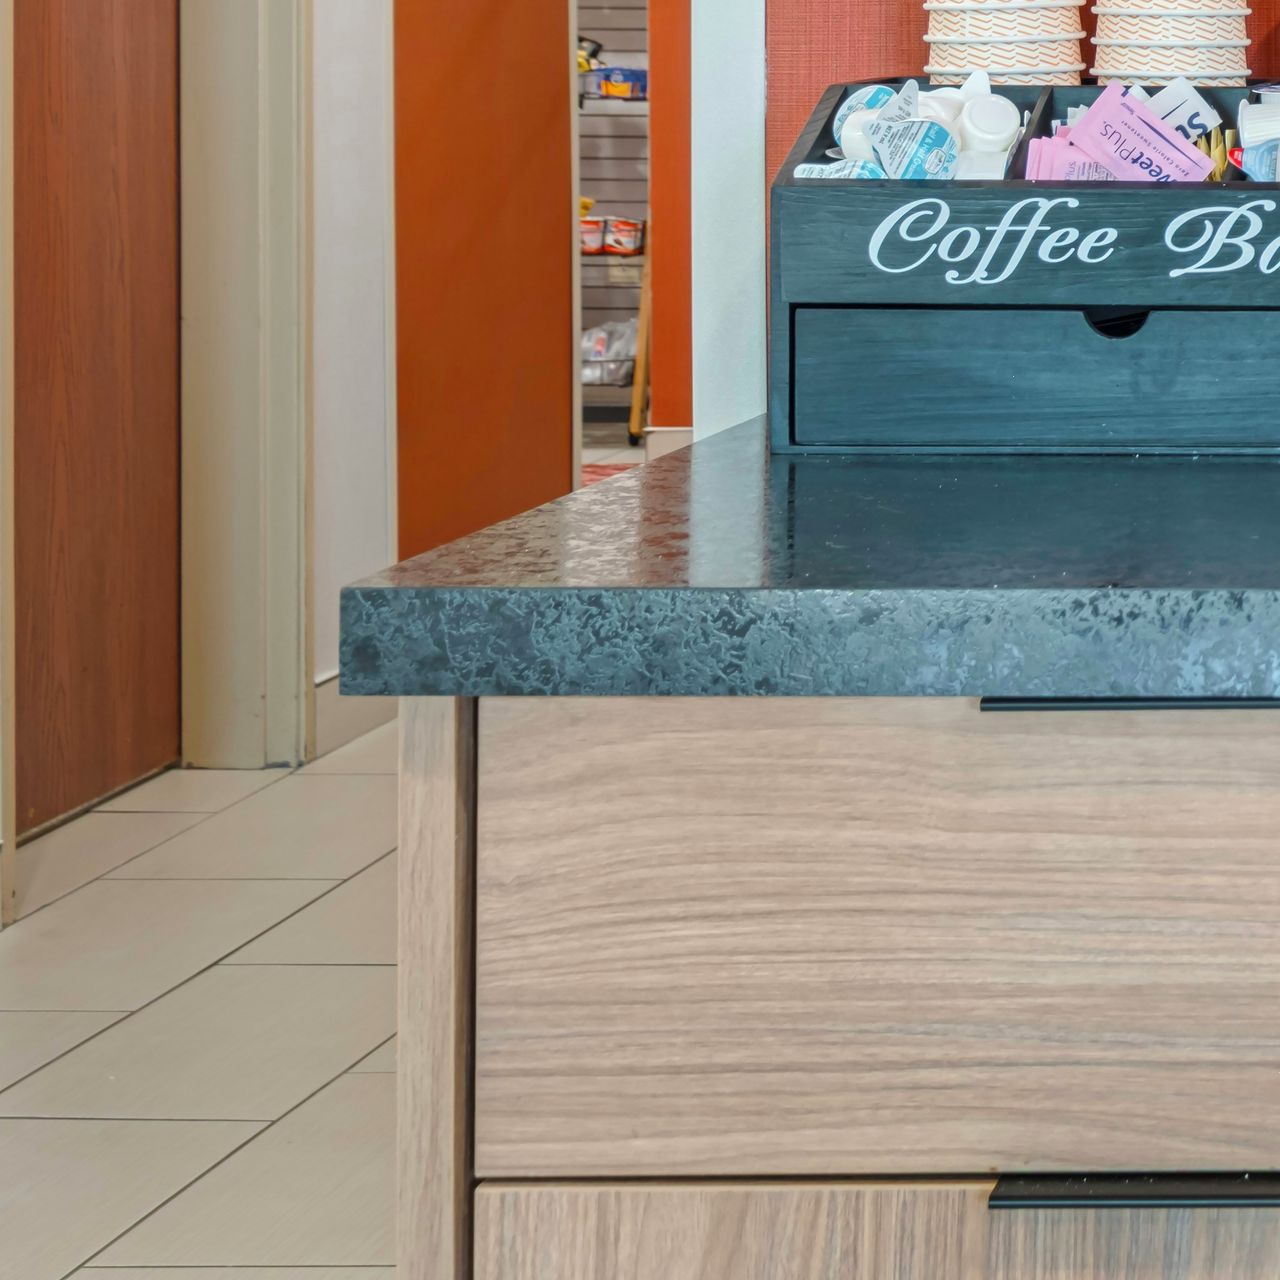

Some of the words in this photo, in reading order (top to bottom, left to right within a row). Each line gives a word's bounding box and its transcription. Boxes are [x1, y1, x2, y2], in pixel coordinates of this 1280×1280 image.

[1119, 120, 1152, 148] Sweetener
[1150, 144, 1175, 166] Calorie
[868, 196, 1119, 285] Coffee
